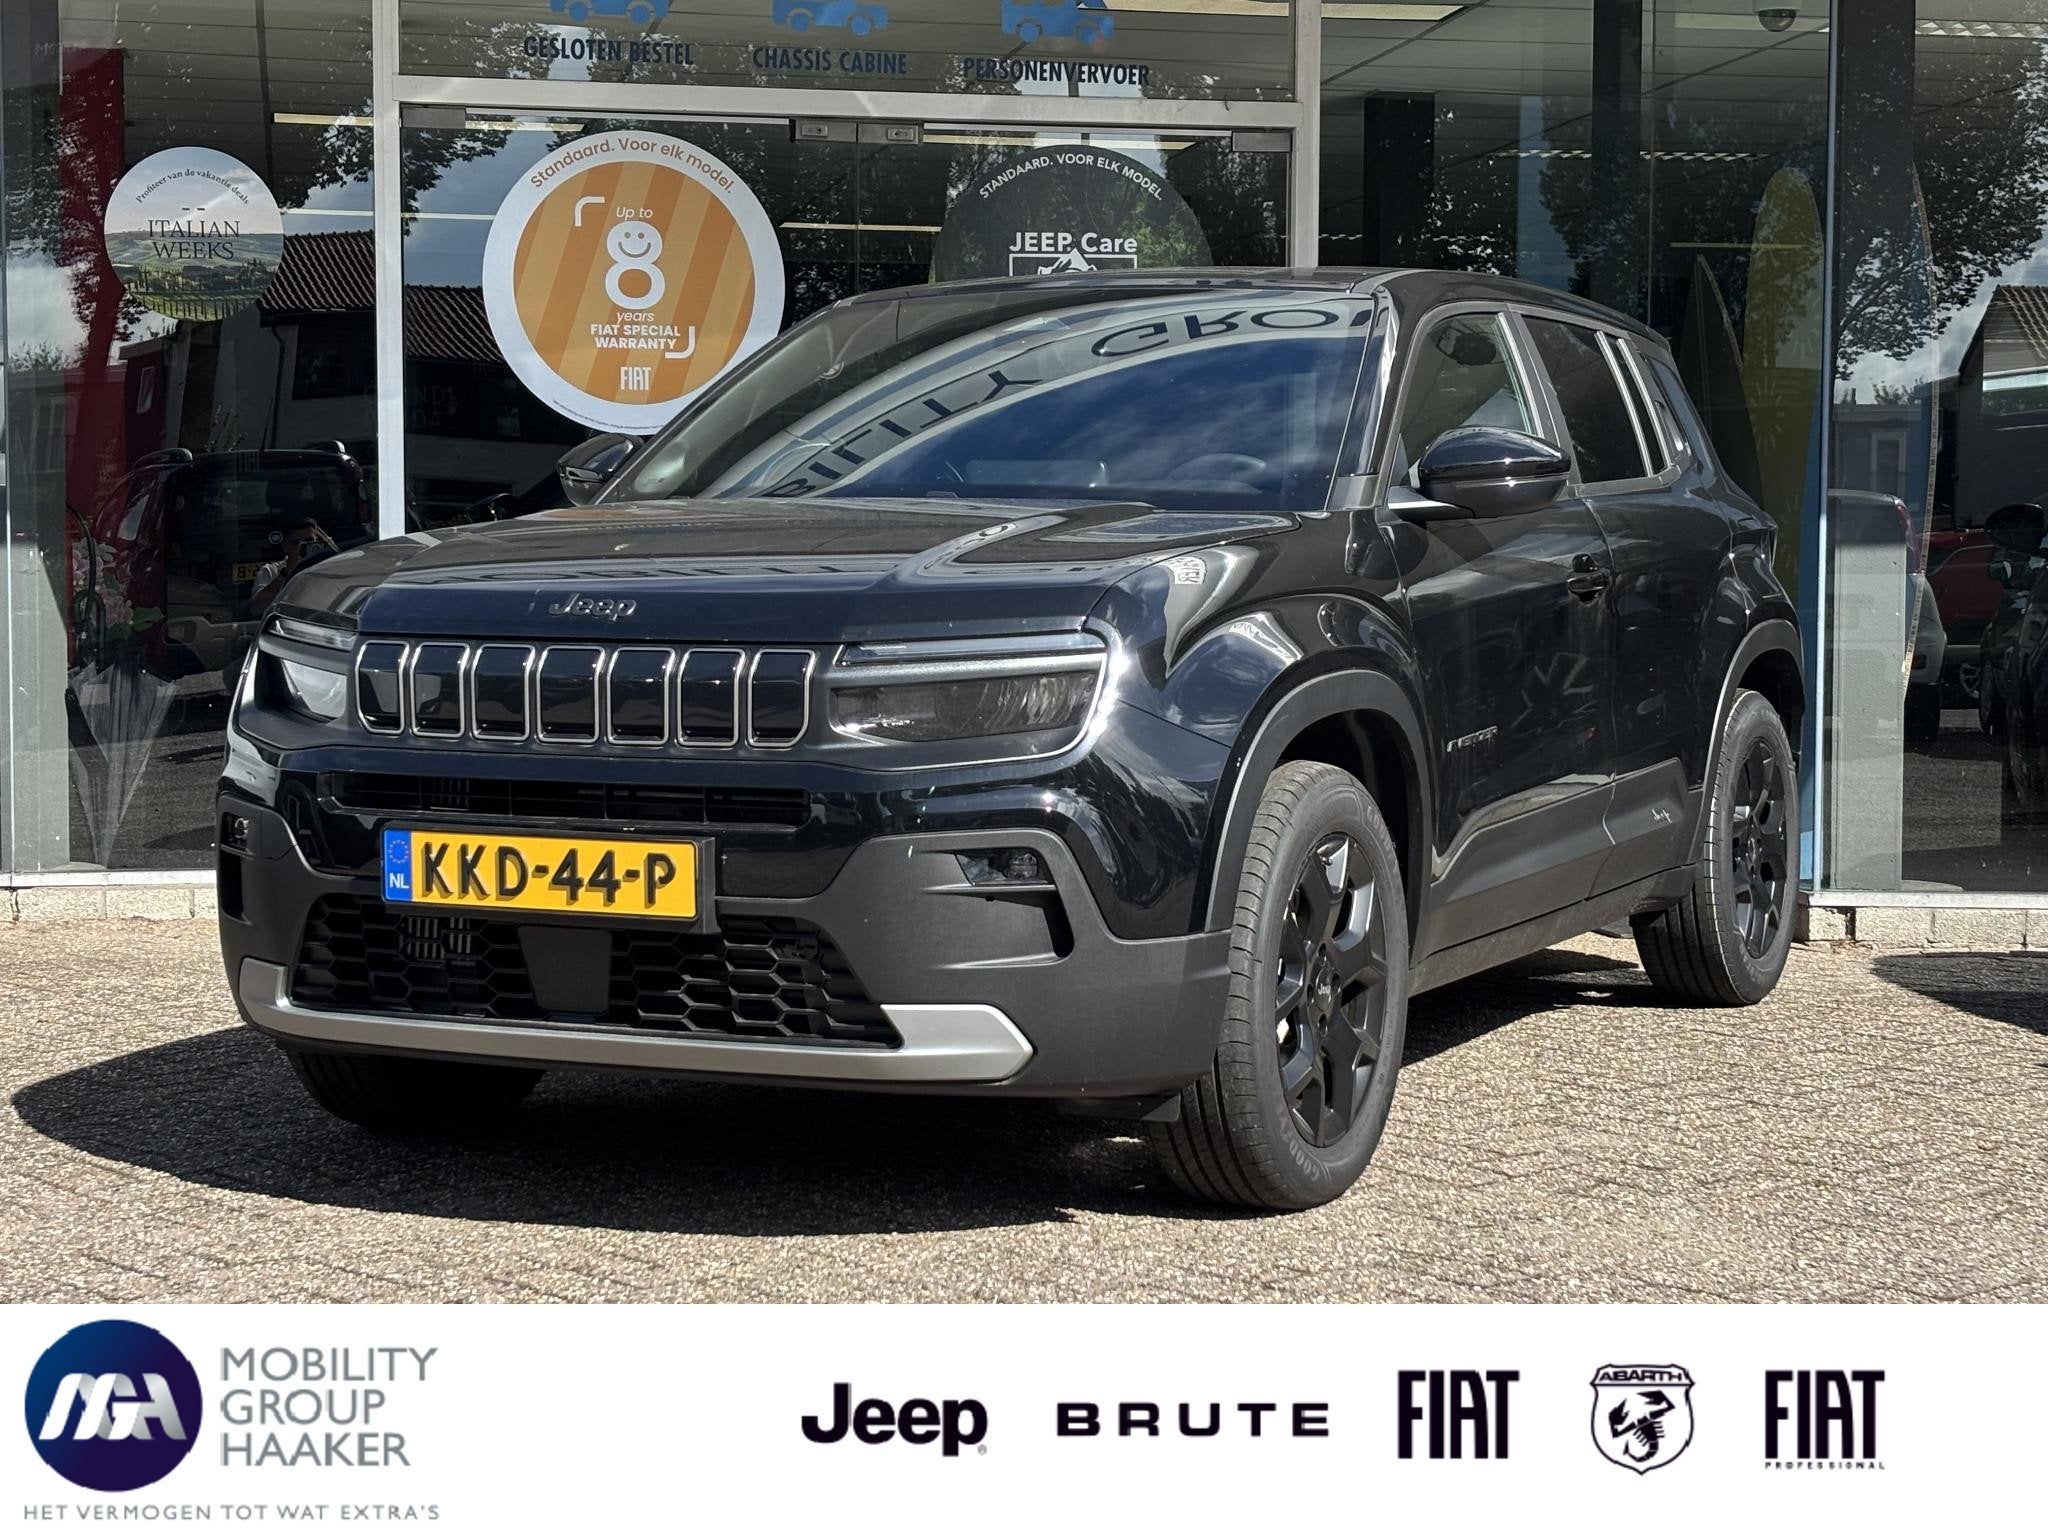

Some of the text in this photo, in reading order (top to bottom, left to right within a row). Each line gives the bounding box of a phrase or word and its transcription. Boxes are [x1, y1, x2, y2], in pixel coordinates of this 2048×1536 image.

[523, 36, 694, 66] GESLOTEN BESTEL
[752, 47, 907, 74] CHASSIS CABINE
[963, 58, 1150, 86] PERSONENVERVOER
[530, 137, 735, 194] Standaard. Voor elk model.
[979, 153, 1163, 201] STANDAARD. VOOR ELK MODEL.
[135, 168, 249, 205] Profiteer van de vakantie deals
[616, 206, 653, 221] Up to
[148, 219, 240, 238] ITALIAN
[151, 241, 234, 260] WEEKS
[1081, 232, 1138, 253] Care
[605, 220, 666, 310] 8
[590, 324, 681, 337] FIAT SPECIAL
[616, 311, 655, 325] years
[595, 337, 677, 350] WARRANTY
[619, 366, 652, 391] FIAT
[548, 593, 637, 622] Jeep
[389, 872, 410, 889] NL
[421, 841, 676, 908] KKD-44-P
